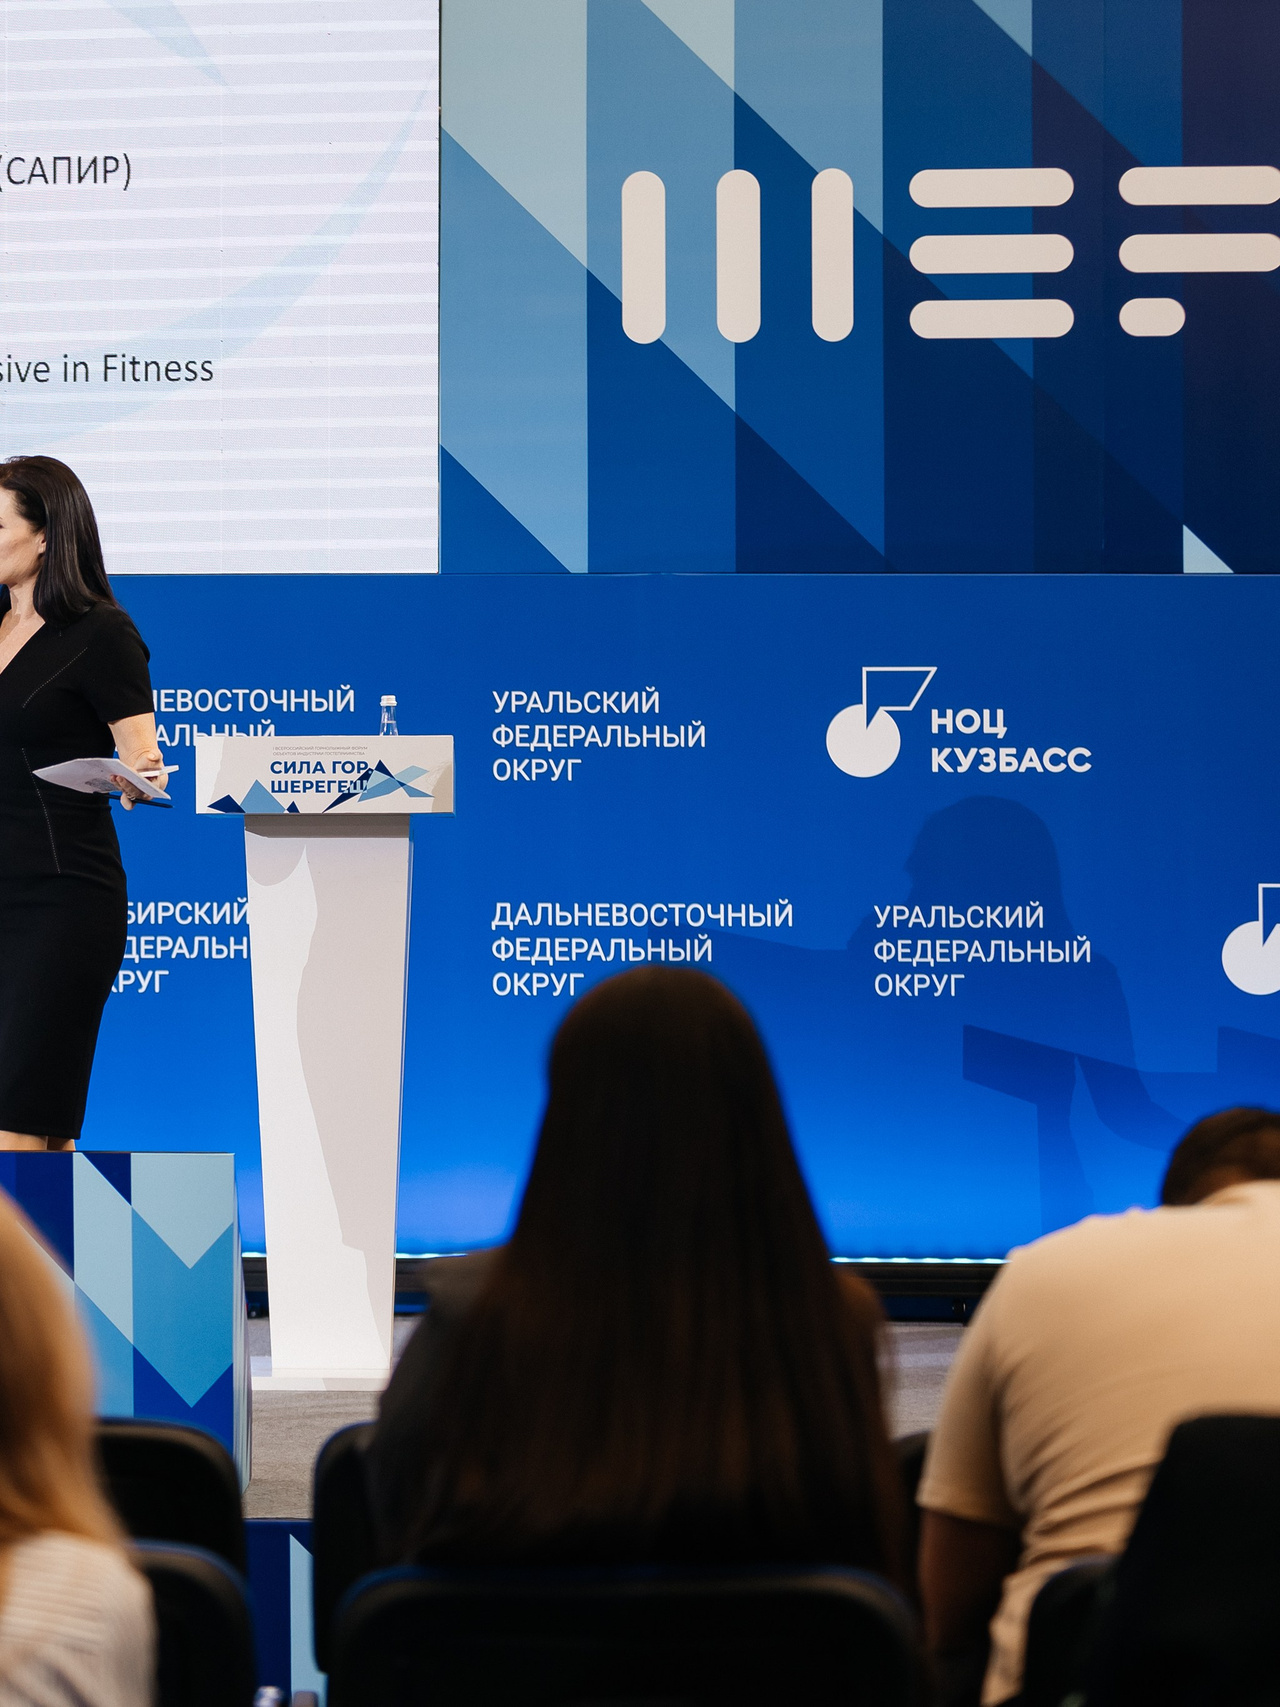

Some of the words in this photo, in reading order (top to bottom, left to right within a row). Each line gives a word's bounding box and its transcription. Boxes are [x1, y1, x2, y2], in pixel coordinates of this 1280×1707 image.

[62, 352, 90, 384] in
[102, 352, 215, 384] Fitness
[153, 684, 356, 713] ЕВОСТОЧНЫЙ
[492, 686, 660, 714] УРАЛЬСКИЙ
[492, 720, 706, 752] ФЕДЕРАЛЬНЫЙ
[931, 708, 1008, 739] НОЦ
[270, 760, 326, 775] СИЛА
[492, 758, 582, 782] ОКРУГ
[931, 746, 1092, 773] КУЗБАСС
[270, 779, 368, 794] ШЕРЕГЕШ
[491, 898, 793, 931] ДАЛЬНЕВОСТОЧНЫЙ
[873, 900, 1044, 929] УРАЛЬСКИЙ
[123, 935, 248, 964] ДЕРАЛЬН
[491, 933, 712, 967] ФЕДЕРАЛЬНЫЙ
[873, 935, 1091, 968] ФЕДЕРАЛЬНЫЙ
[110, 969, 170, 994] РУГ
[492, 972, 585, 997] ОКРУГ
[874, 973, 965, 997] ОКРУГ
